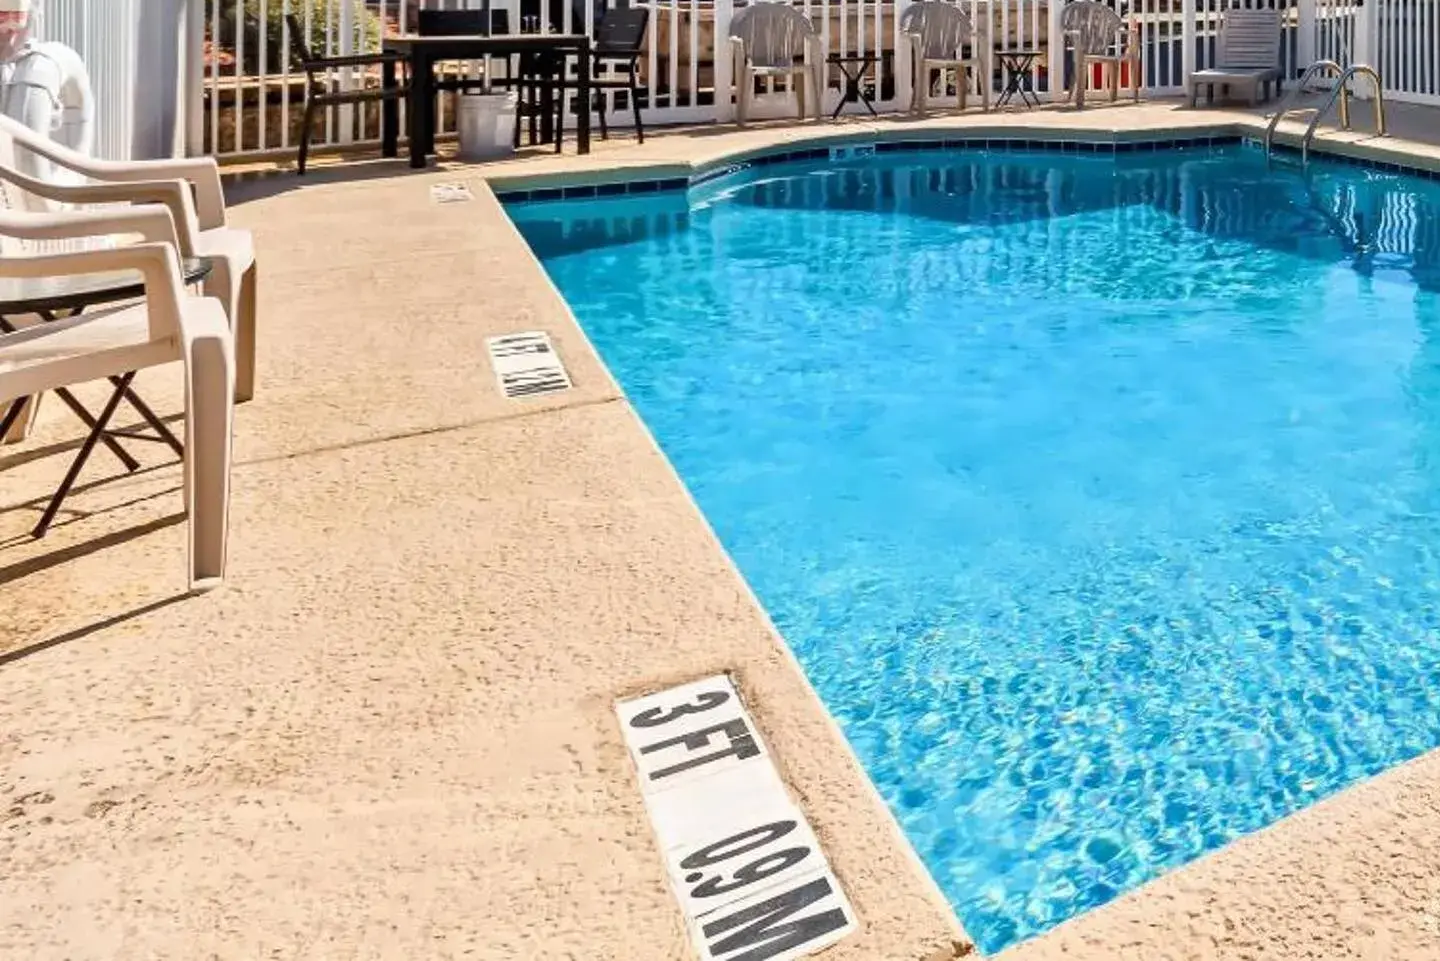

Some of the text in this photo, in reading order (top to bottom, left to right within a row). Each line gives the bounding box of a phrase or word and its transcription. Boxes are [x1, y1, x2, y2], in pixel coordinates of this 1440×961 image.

[629, 691, 849, 961] 3 FT 0.9M
